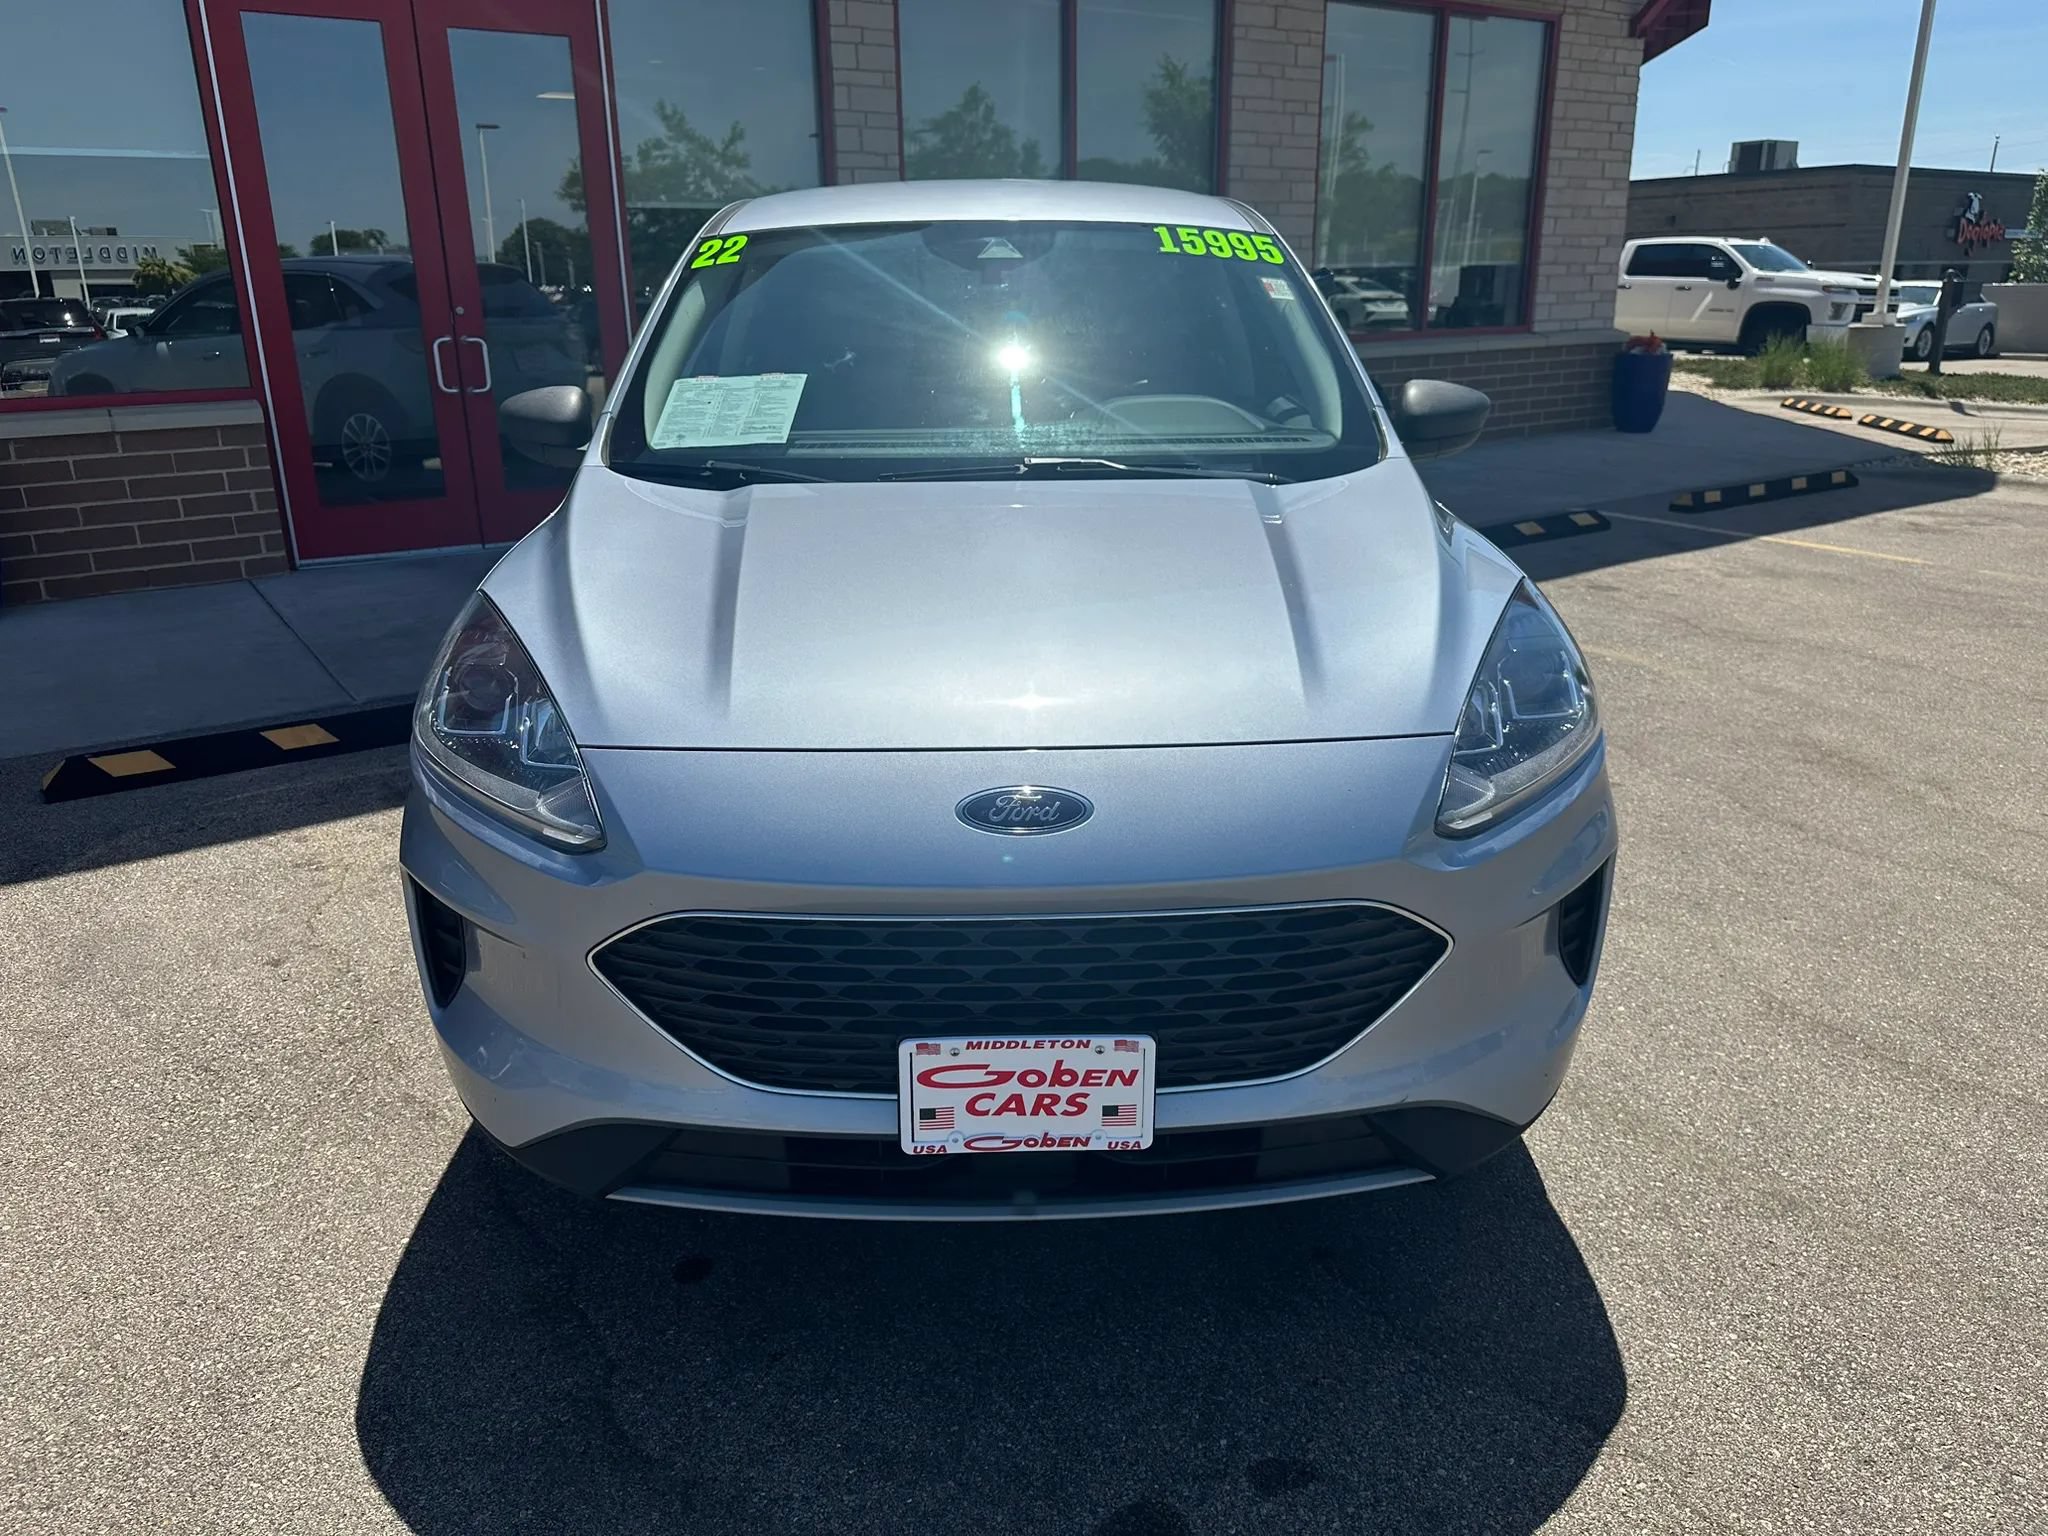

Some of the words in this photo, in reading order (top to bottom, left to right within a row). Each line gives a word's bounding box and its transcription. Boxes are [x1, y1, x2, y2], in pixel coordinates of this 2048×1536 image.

[691, 235, 748, 269] 22
[1153, 226, 1285, 265] 15995
[988, 793, 1061, 822] Ford
[965, 1039, 1091, 1051] MIDDLETON
[965, 1092, 1091, 1117] CARS
[913, 1144, 948, 1154] USA
[1107, 1140, 1142, 1150] USA
